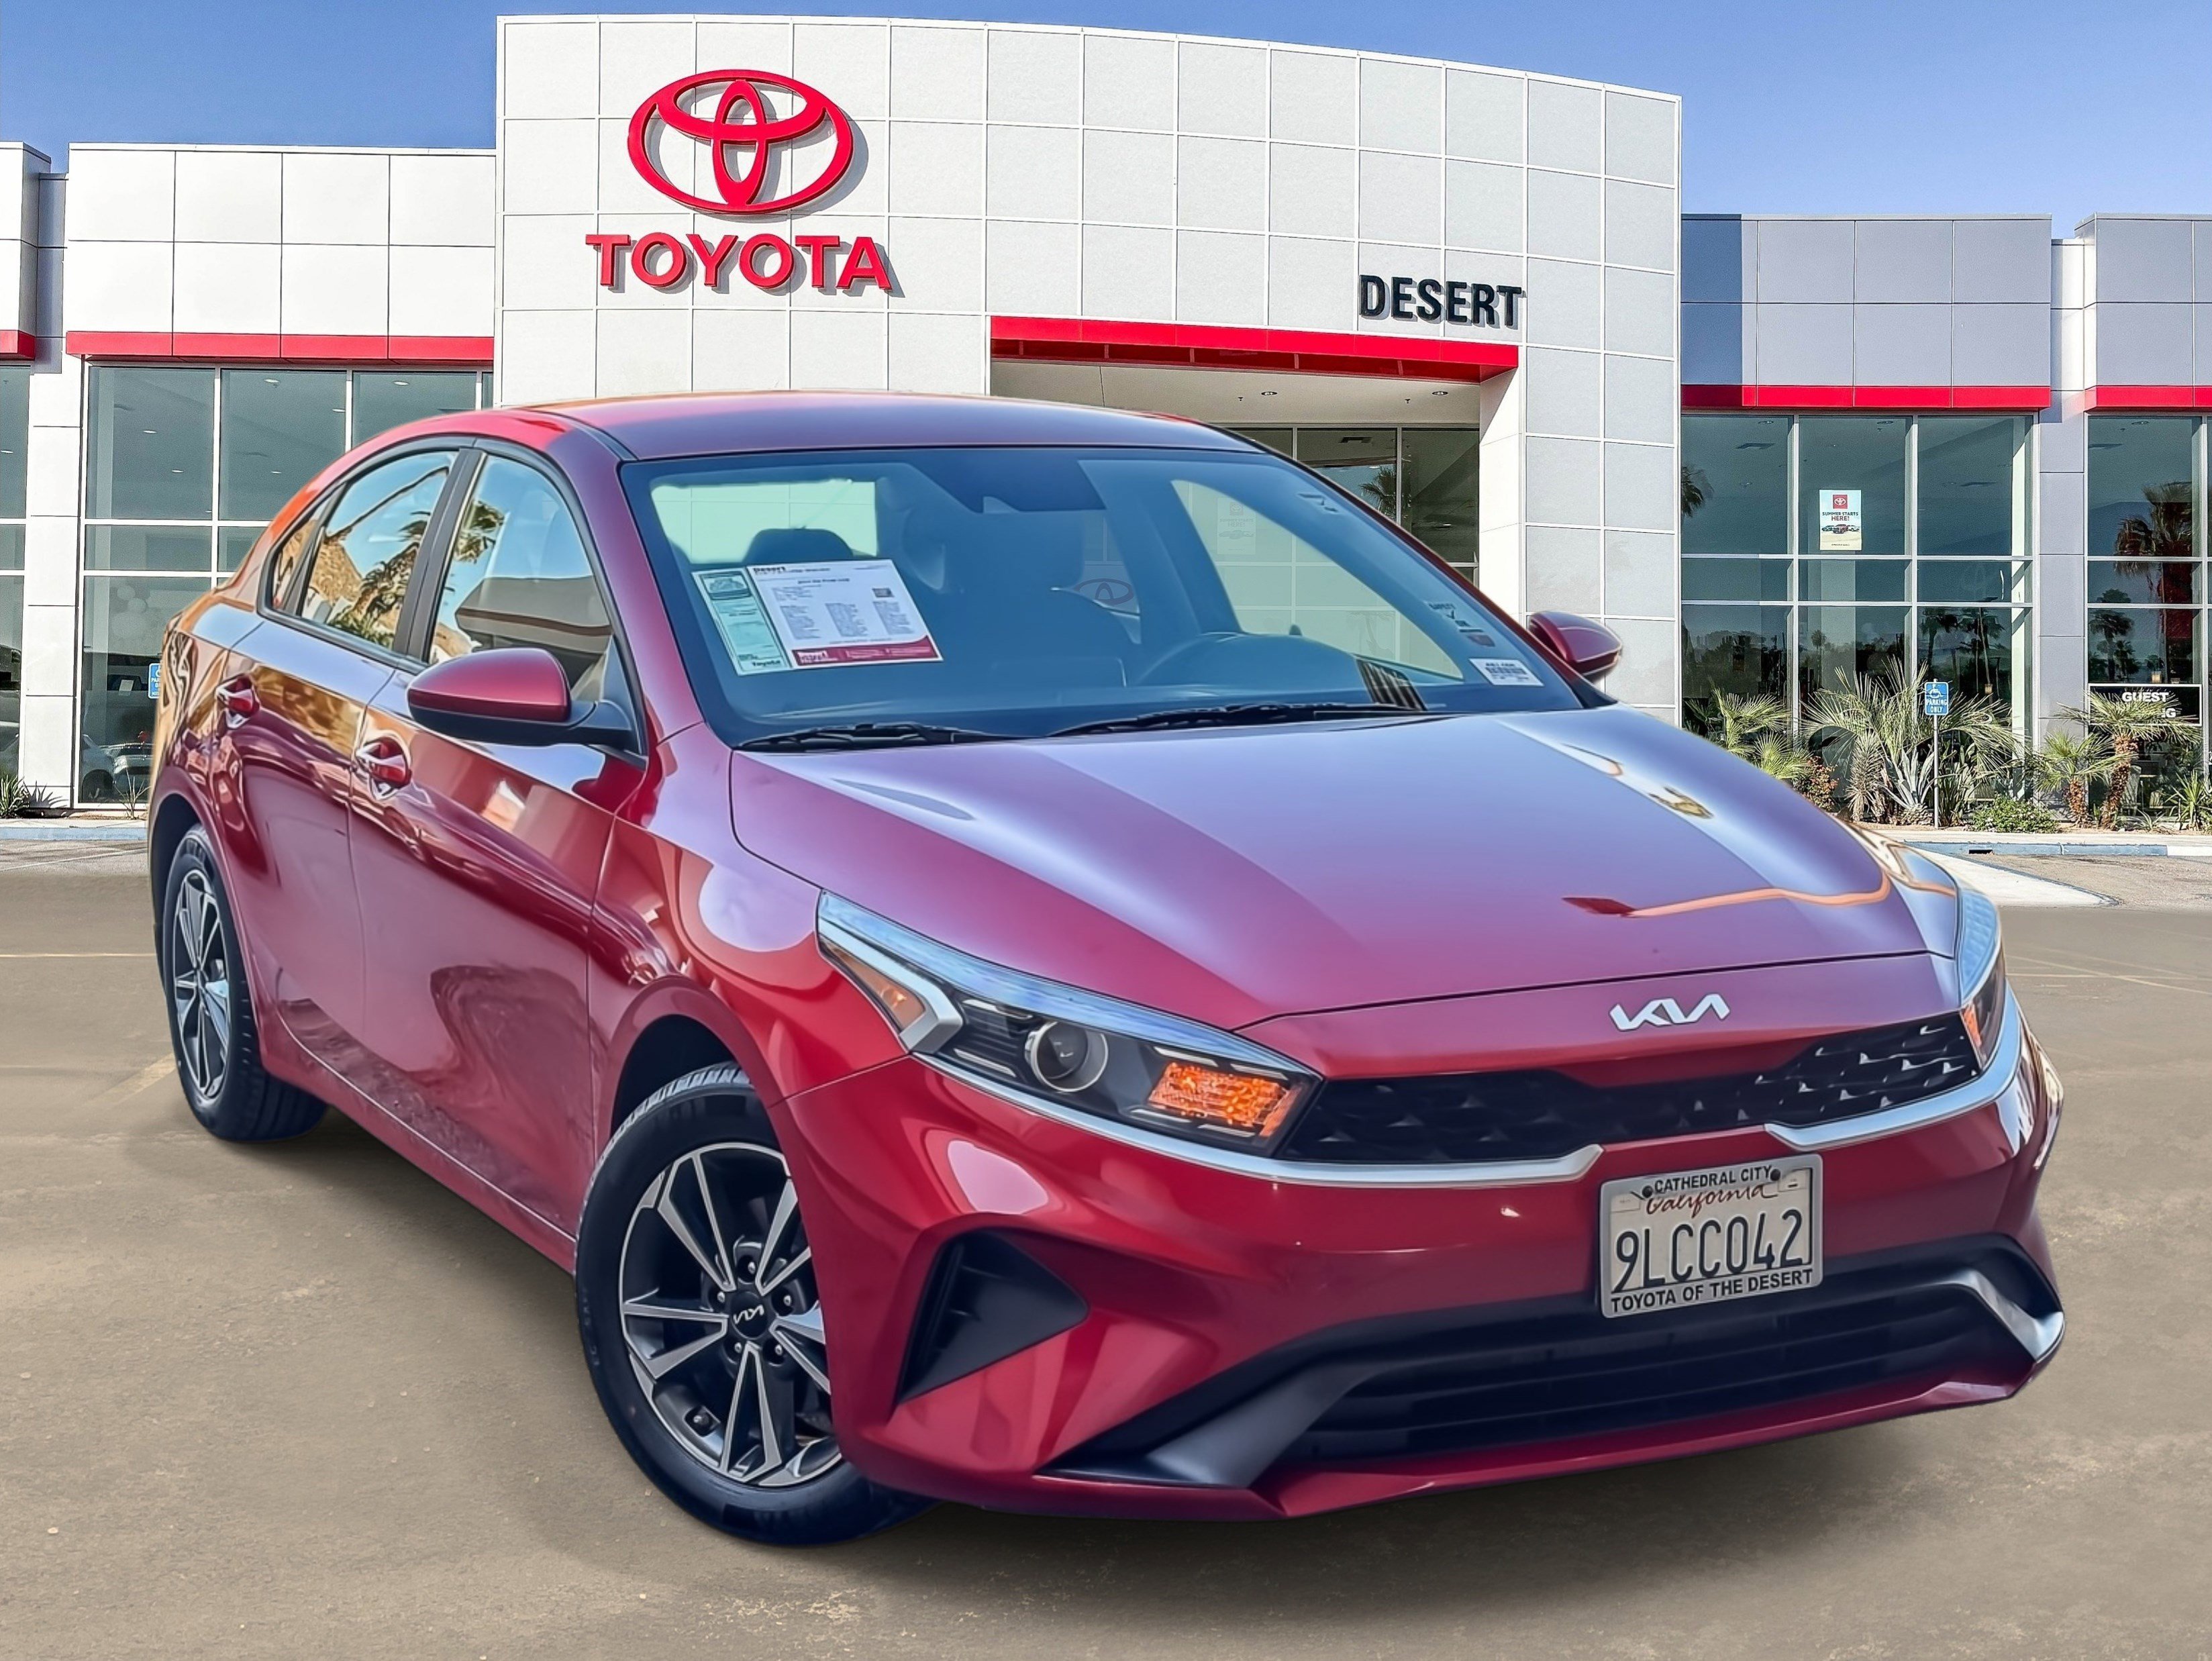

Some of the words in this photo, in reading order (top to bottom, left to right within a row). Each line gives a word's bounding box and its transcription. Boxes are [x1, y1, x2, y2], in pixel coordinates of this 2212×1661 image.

[585, 232, 893, 291] TOYOTA
[1359, 274, 1522, 327] DESERT
[1930, 705, 1944, 713] ONLY
[2121, 691, 2170, 703] GUEST
[1654, 1171, 1736, 1193] CATHEDRAL
[1741, 1164, 1773, 1182] CITY
[1646, 1182, 1778, 1219] California
[1612, 1209, 1803, 1294] 9LCC042
[1611, 1289, 1676, 1313] TOYOTA
[1682, 1284, 1704, 1302] OF
[1710, 1278, 1744, 1298] THE
[1748, 1268, 1813, 1292] DESERT
